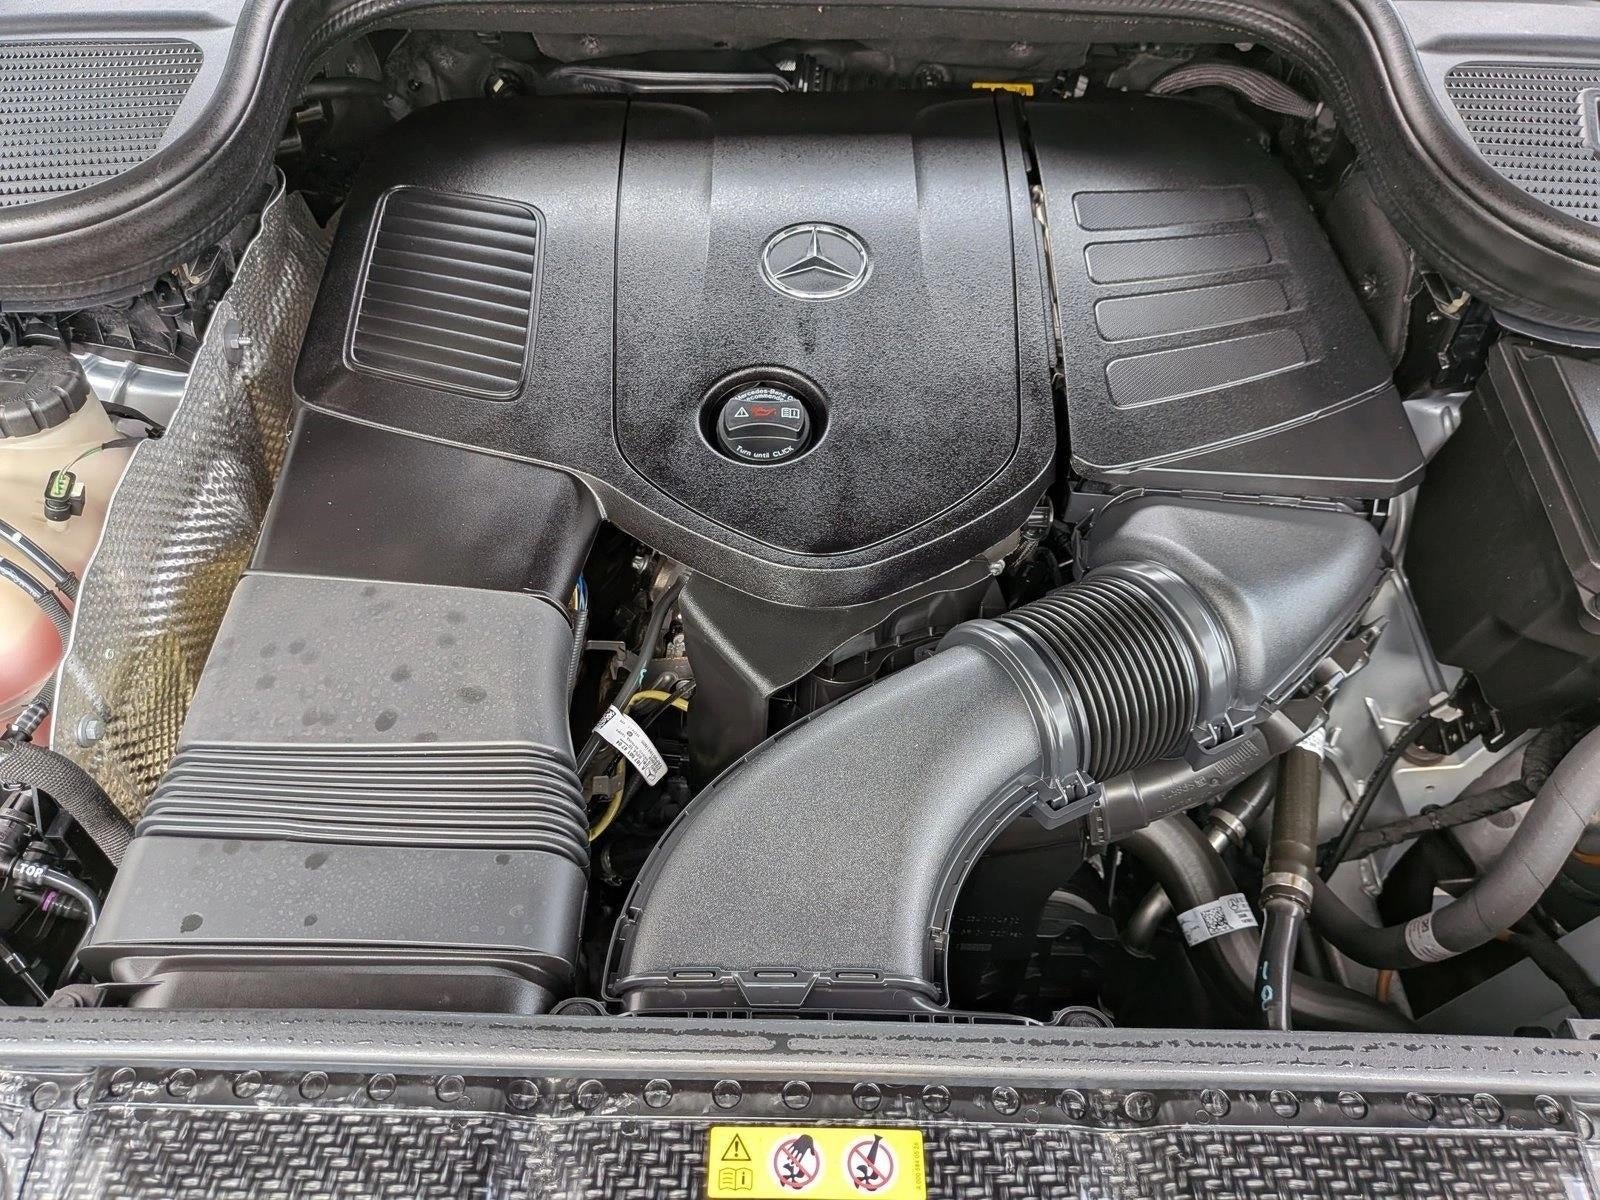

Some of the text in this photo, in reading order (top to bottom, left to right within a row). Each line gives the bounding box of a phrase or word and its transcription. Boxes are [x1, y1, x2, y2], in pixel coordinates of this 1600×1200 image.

[736, 445, 751, 456] Turn
[772, 445, 794, 458] CLICK
[19, 863, 44, 878] TOP
